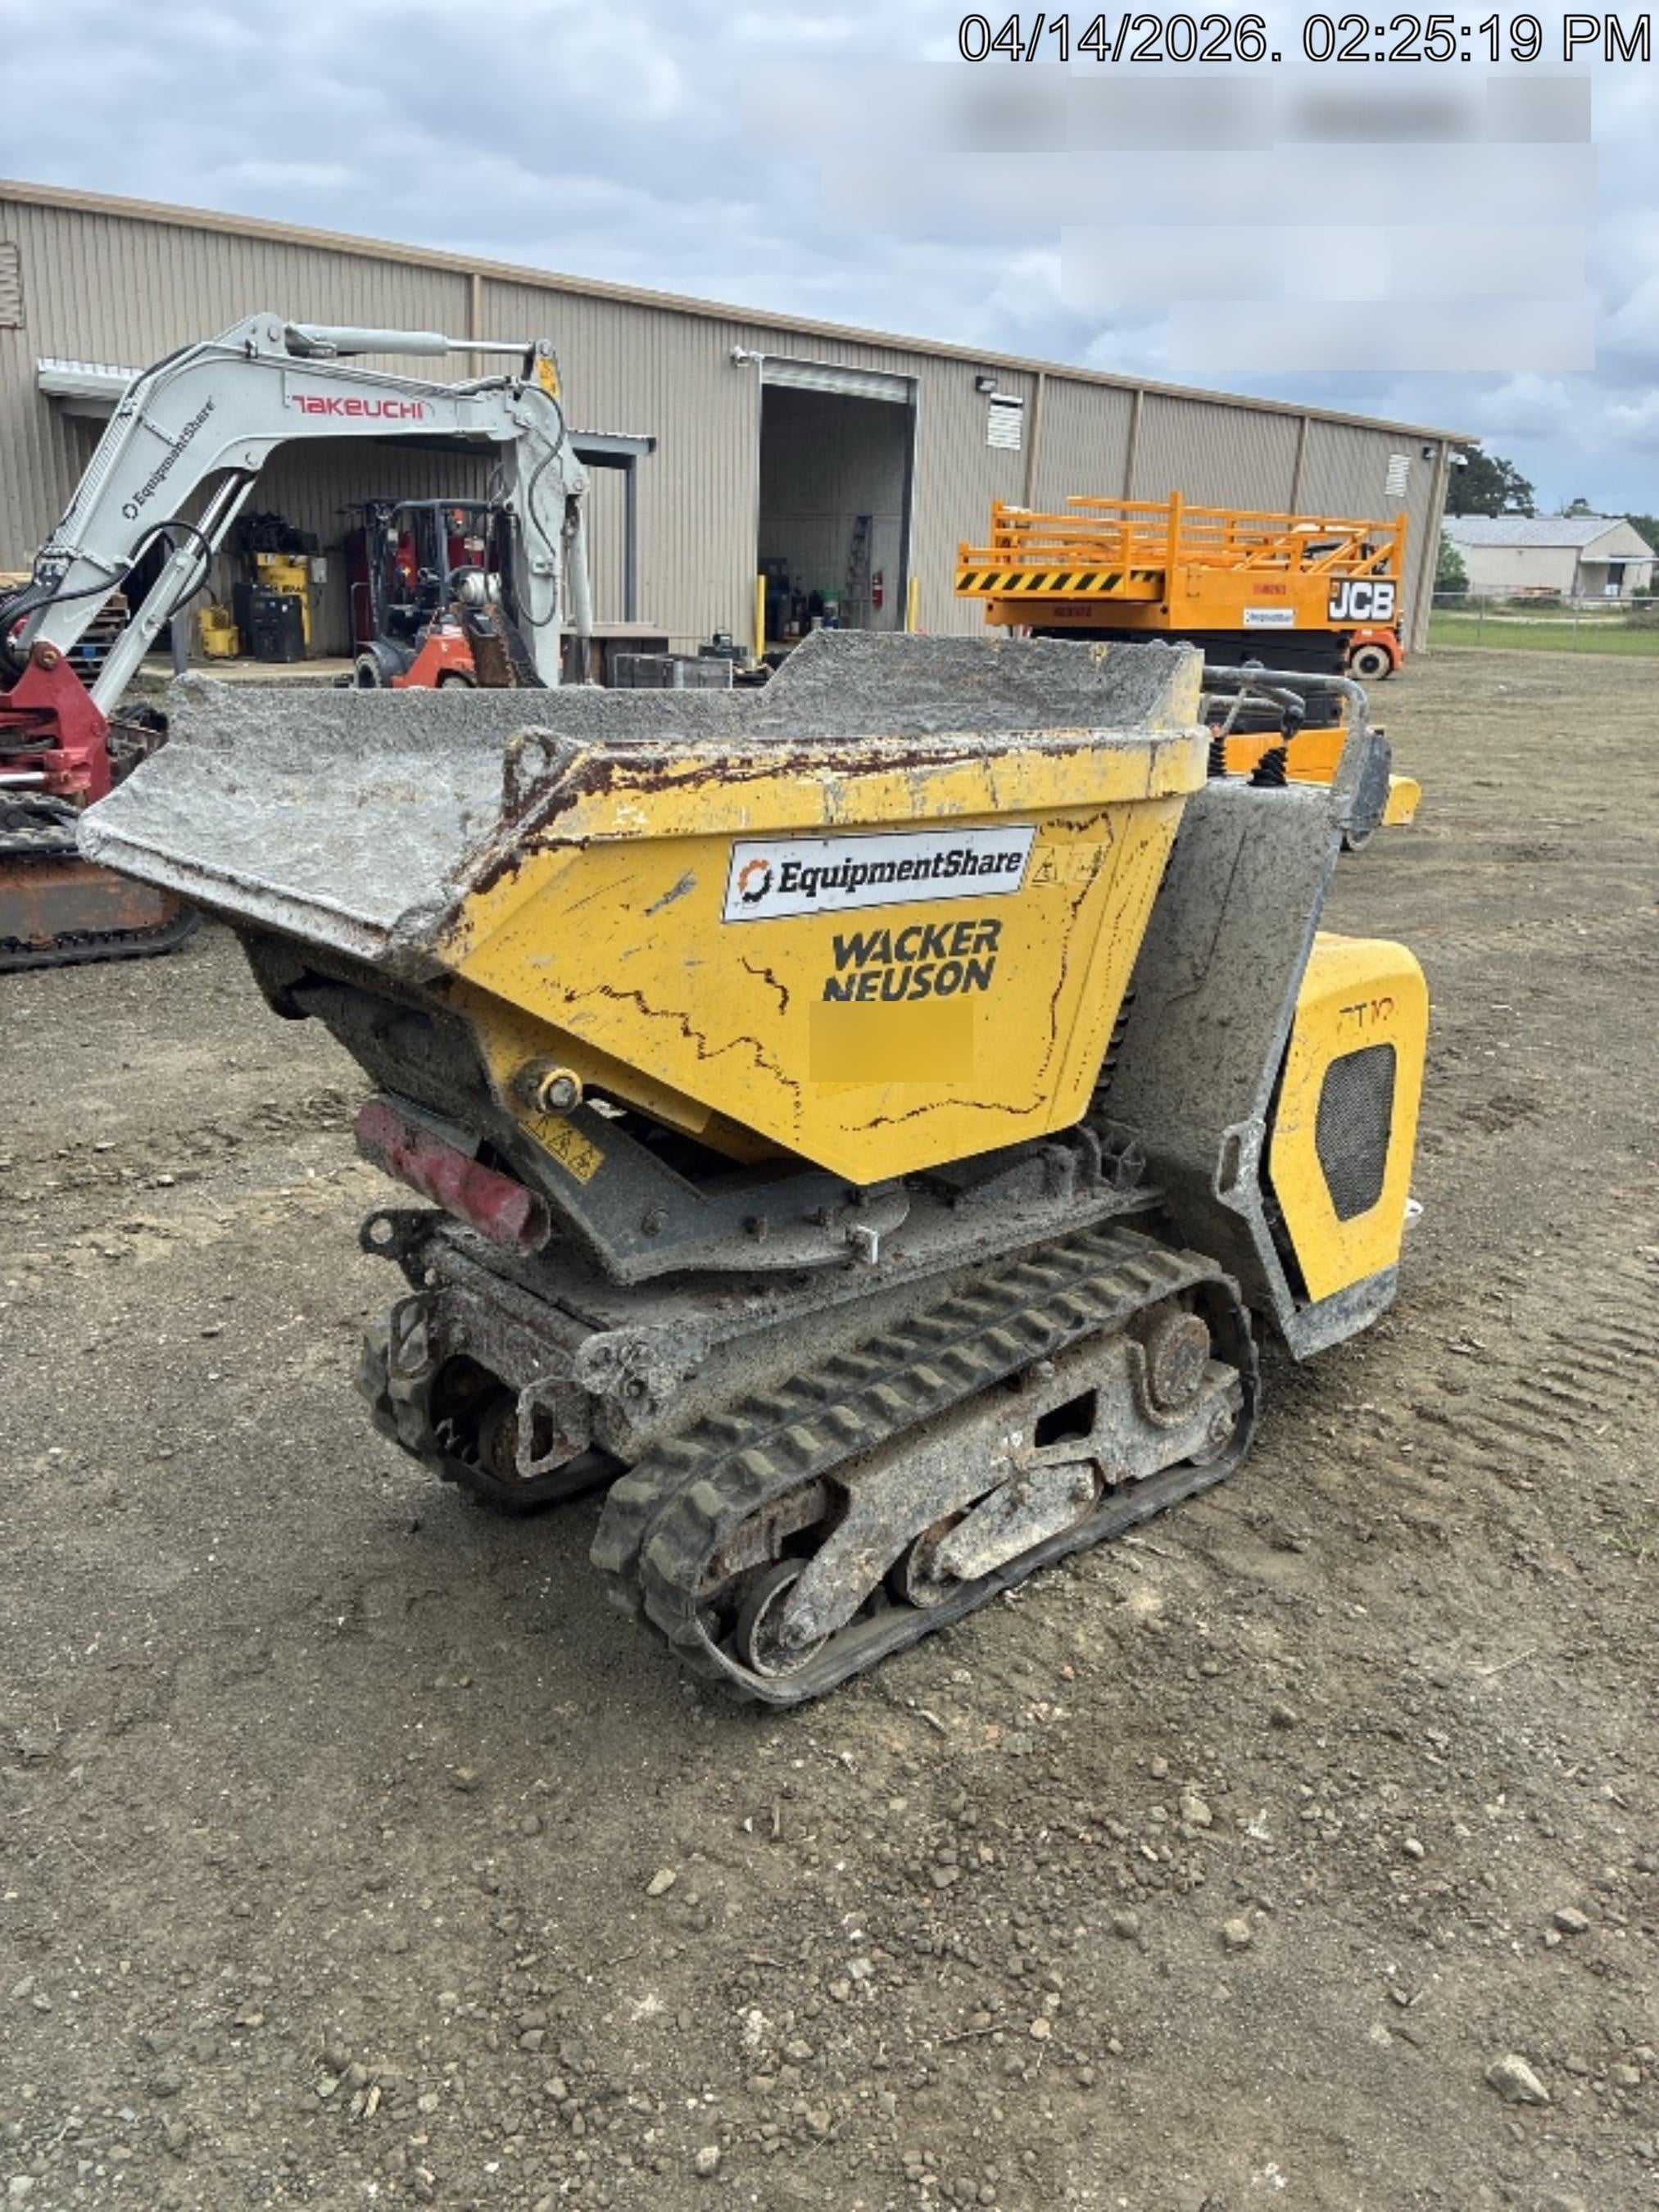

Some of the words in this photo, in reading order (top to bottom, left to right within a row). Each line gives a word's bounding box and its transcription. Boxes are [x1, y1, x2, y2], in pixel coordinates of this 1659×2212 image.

[292, 395, 424, 419] TAKEUCHI
[131, 395, 216, 506] EquipmentShare
[1329, 581, 1395, 620] JCB
[778, 849, 1023, 897] EquipmentShare
[832, 918, 1003, 972] WACKER
[822, 955, 996, 1002] NEUSON
